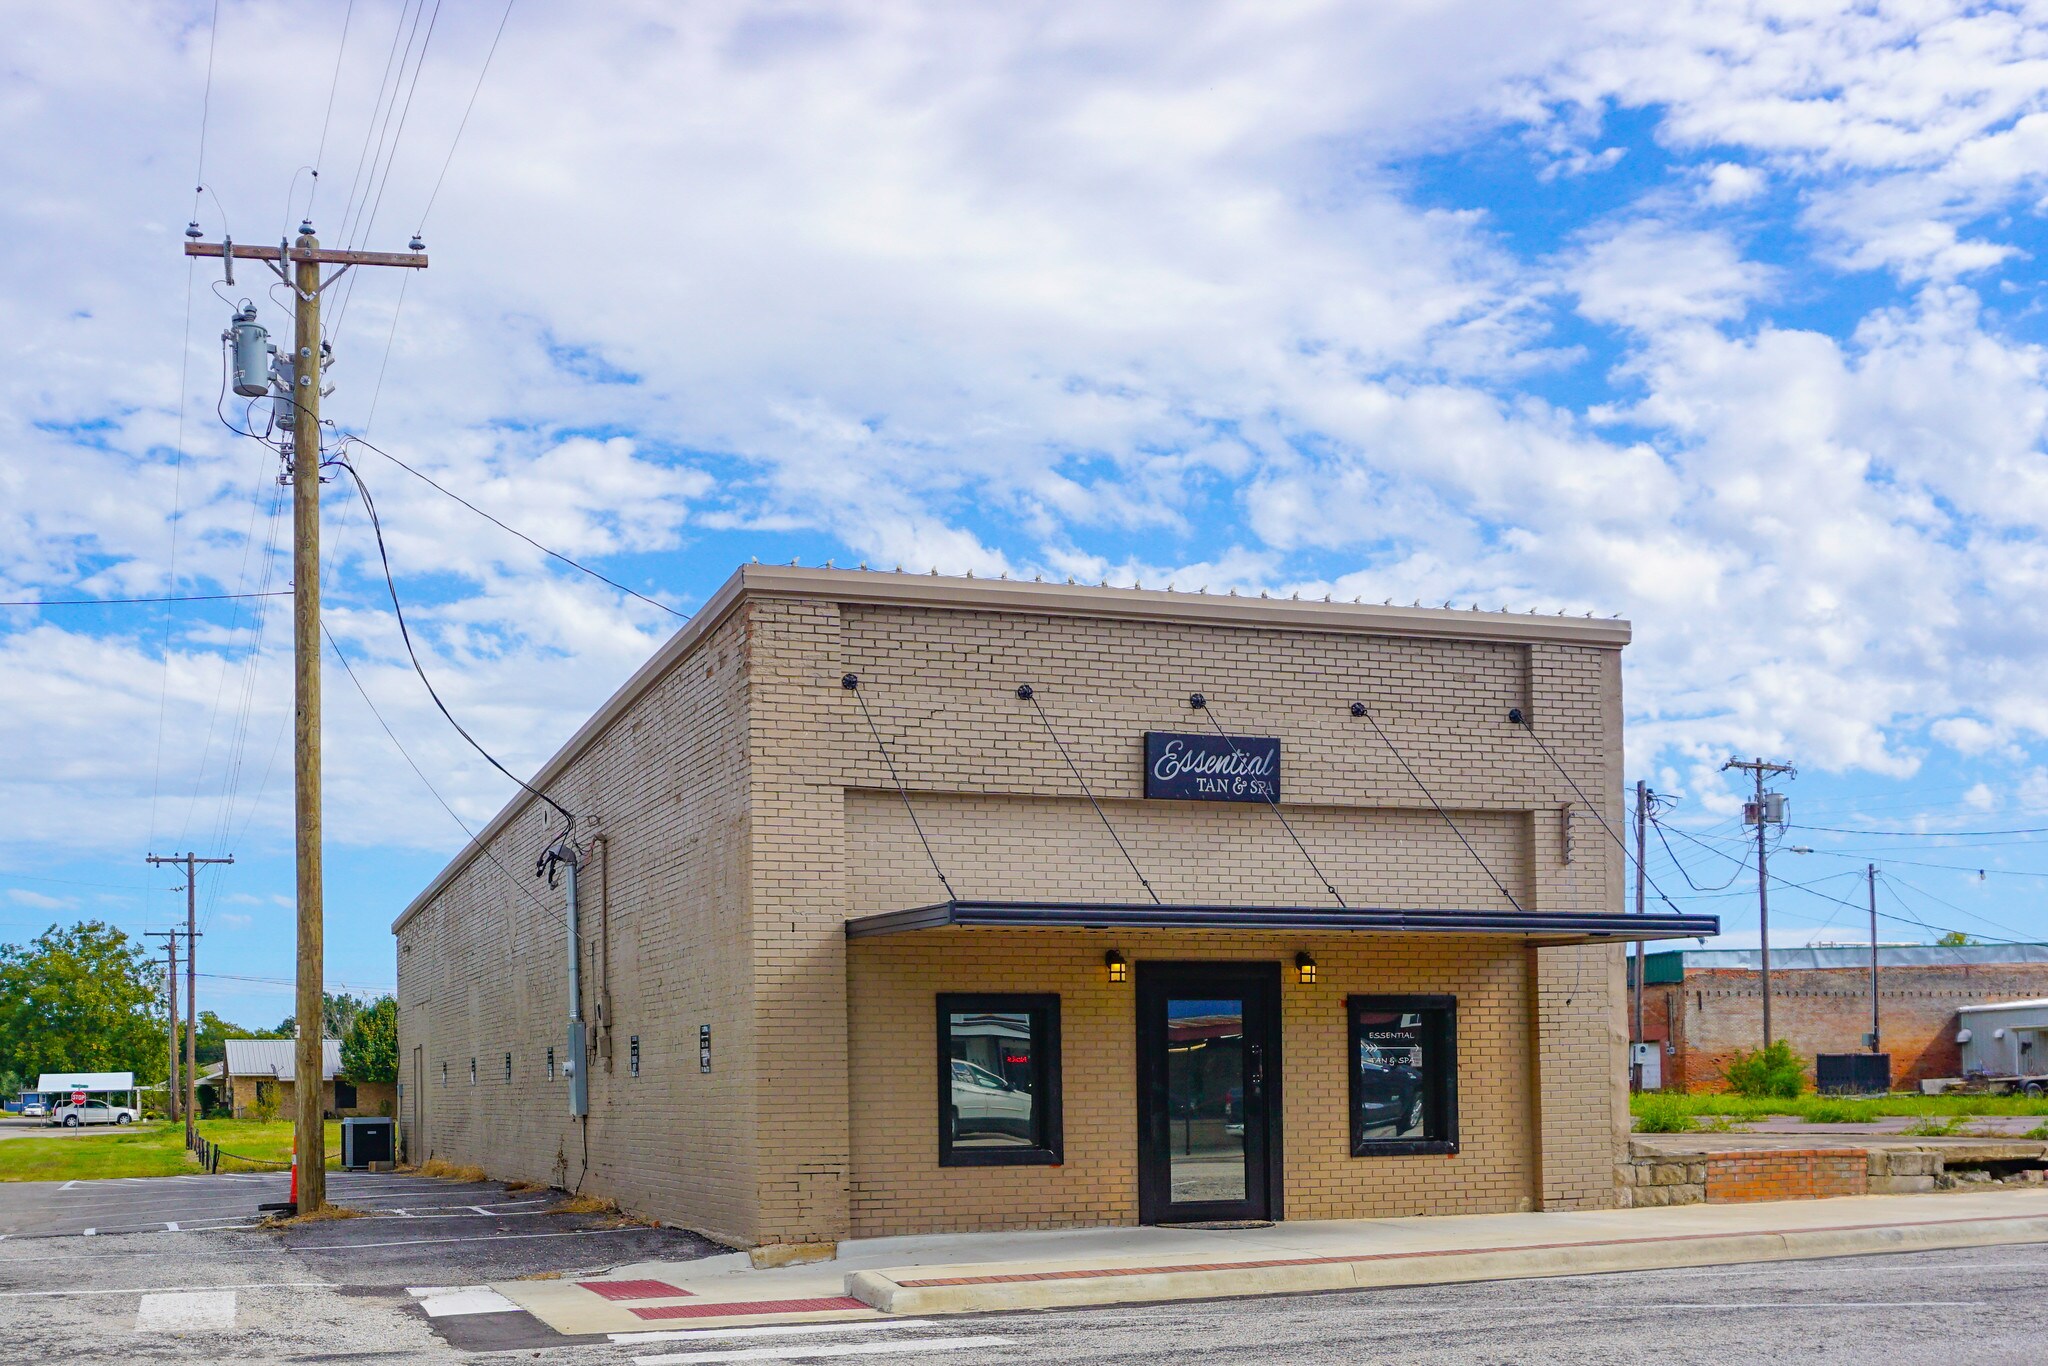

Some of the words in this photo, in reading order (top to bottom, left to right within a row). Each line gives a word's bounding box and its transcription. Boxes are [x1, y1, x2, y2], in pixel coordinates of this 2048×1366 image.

[1154, 740, 1274, 780] Essential
[1197, 777, 1229, 793] TAN
[1232, 776, 1248, 795] &
[1250, 780, 1275, 795] SPA
[1389, 1056, 1395, 1066] &
